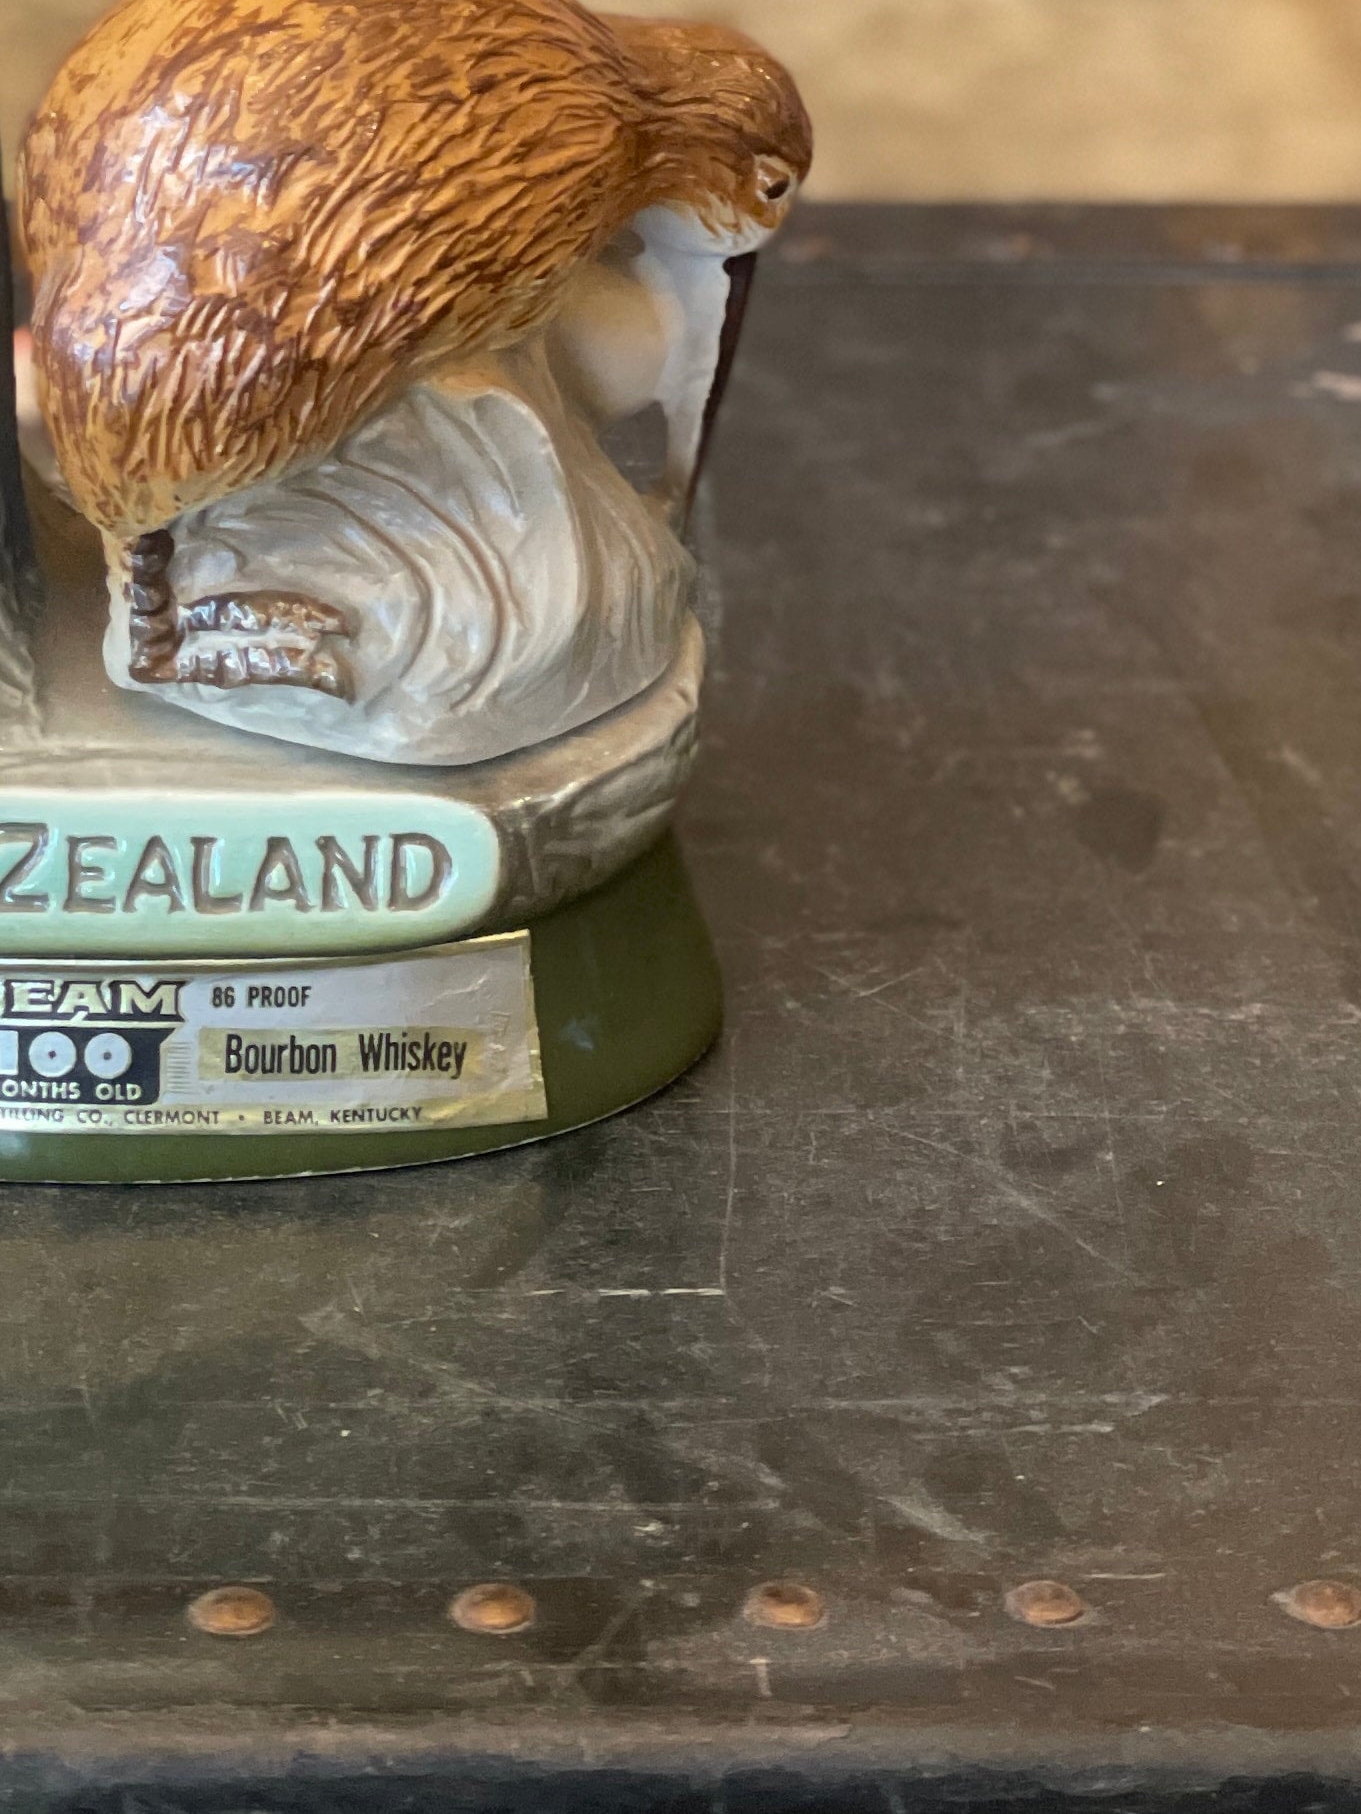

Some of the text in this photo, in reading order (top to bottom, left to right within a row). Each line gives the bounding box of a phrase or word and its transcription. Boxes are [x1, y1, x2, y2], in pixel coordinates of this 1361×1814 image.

[211, 985, 312, 1009] 86 PROOF
[224, 1031, 468, 1080] Bourbon Whiskey
[94, 1082, 143, 1102] OLD
[123, 1109, 220, 1126] CLERMONT
[263, 1109, 320, 1128] BEAM,
[330, 1105, 423, 1124] KENTUCKY
